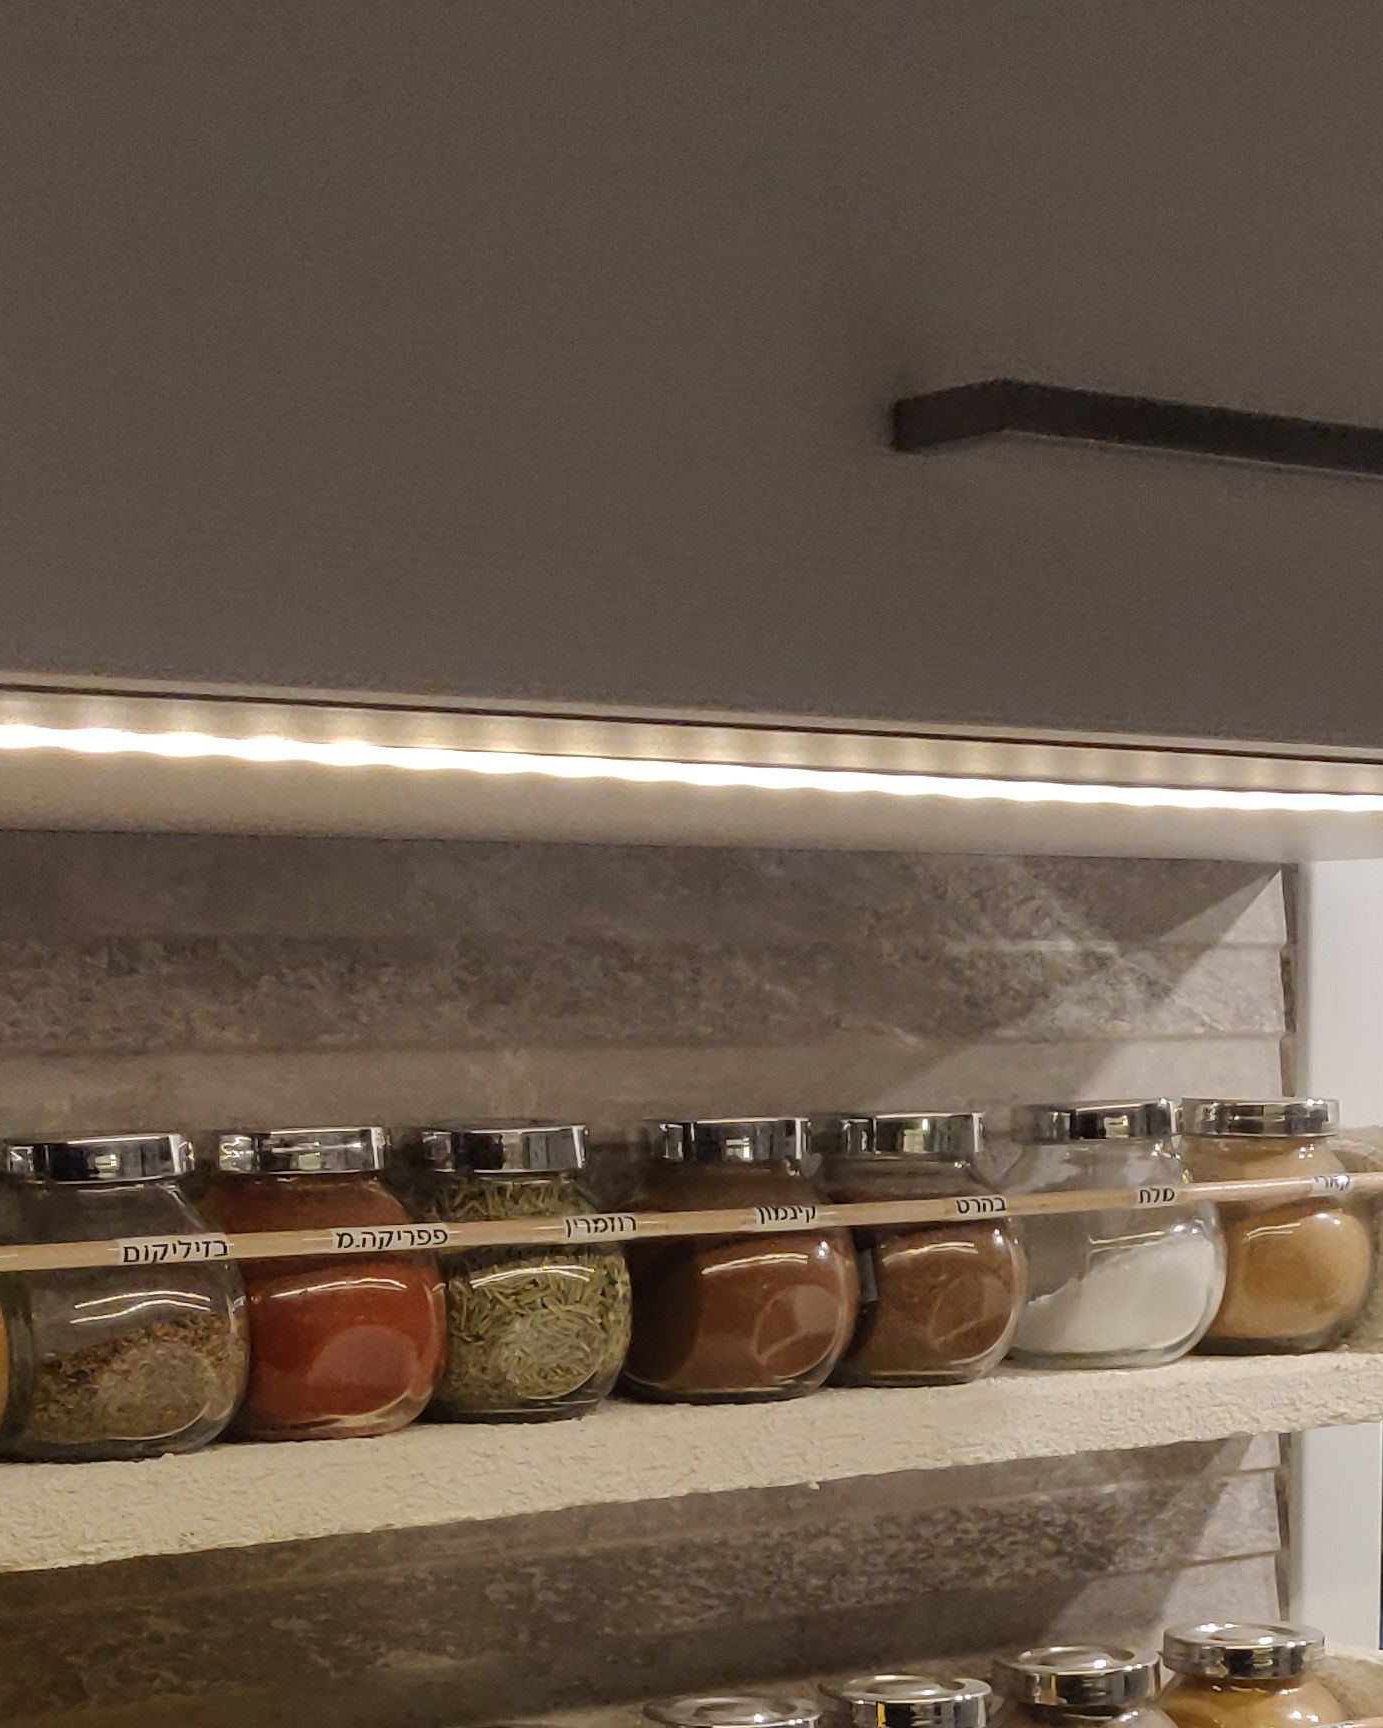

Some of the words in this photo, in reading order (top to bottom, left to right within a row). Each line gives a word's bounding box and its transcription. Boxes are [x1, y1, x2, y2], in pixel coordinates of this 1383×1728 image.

[1139, 1187, 1175, 1204] מלח
[758, 1205, 816, 1224] קינמון
[956, 1197, 1006, 1214] בהרט
[565, 1216, 637, 1238] רוזמרין
[336, 1229, 449, 1249] פפריקה.מ
[122, 1240, 229, 1264] בזיליקום
